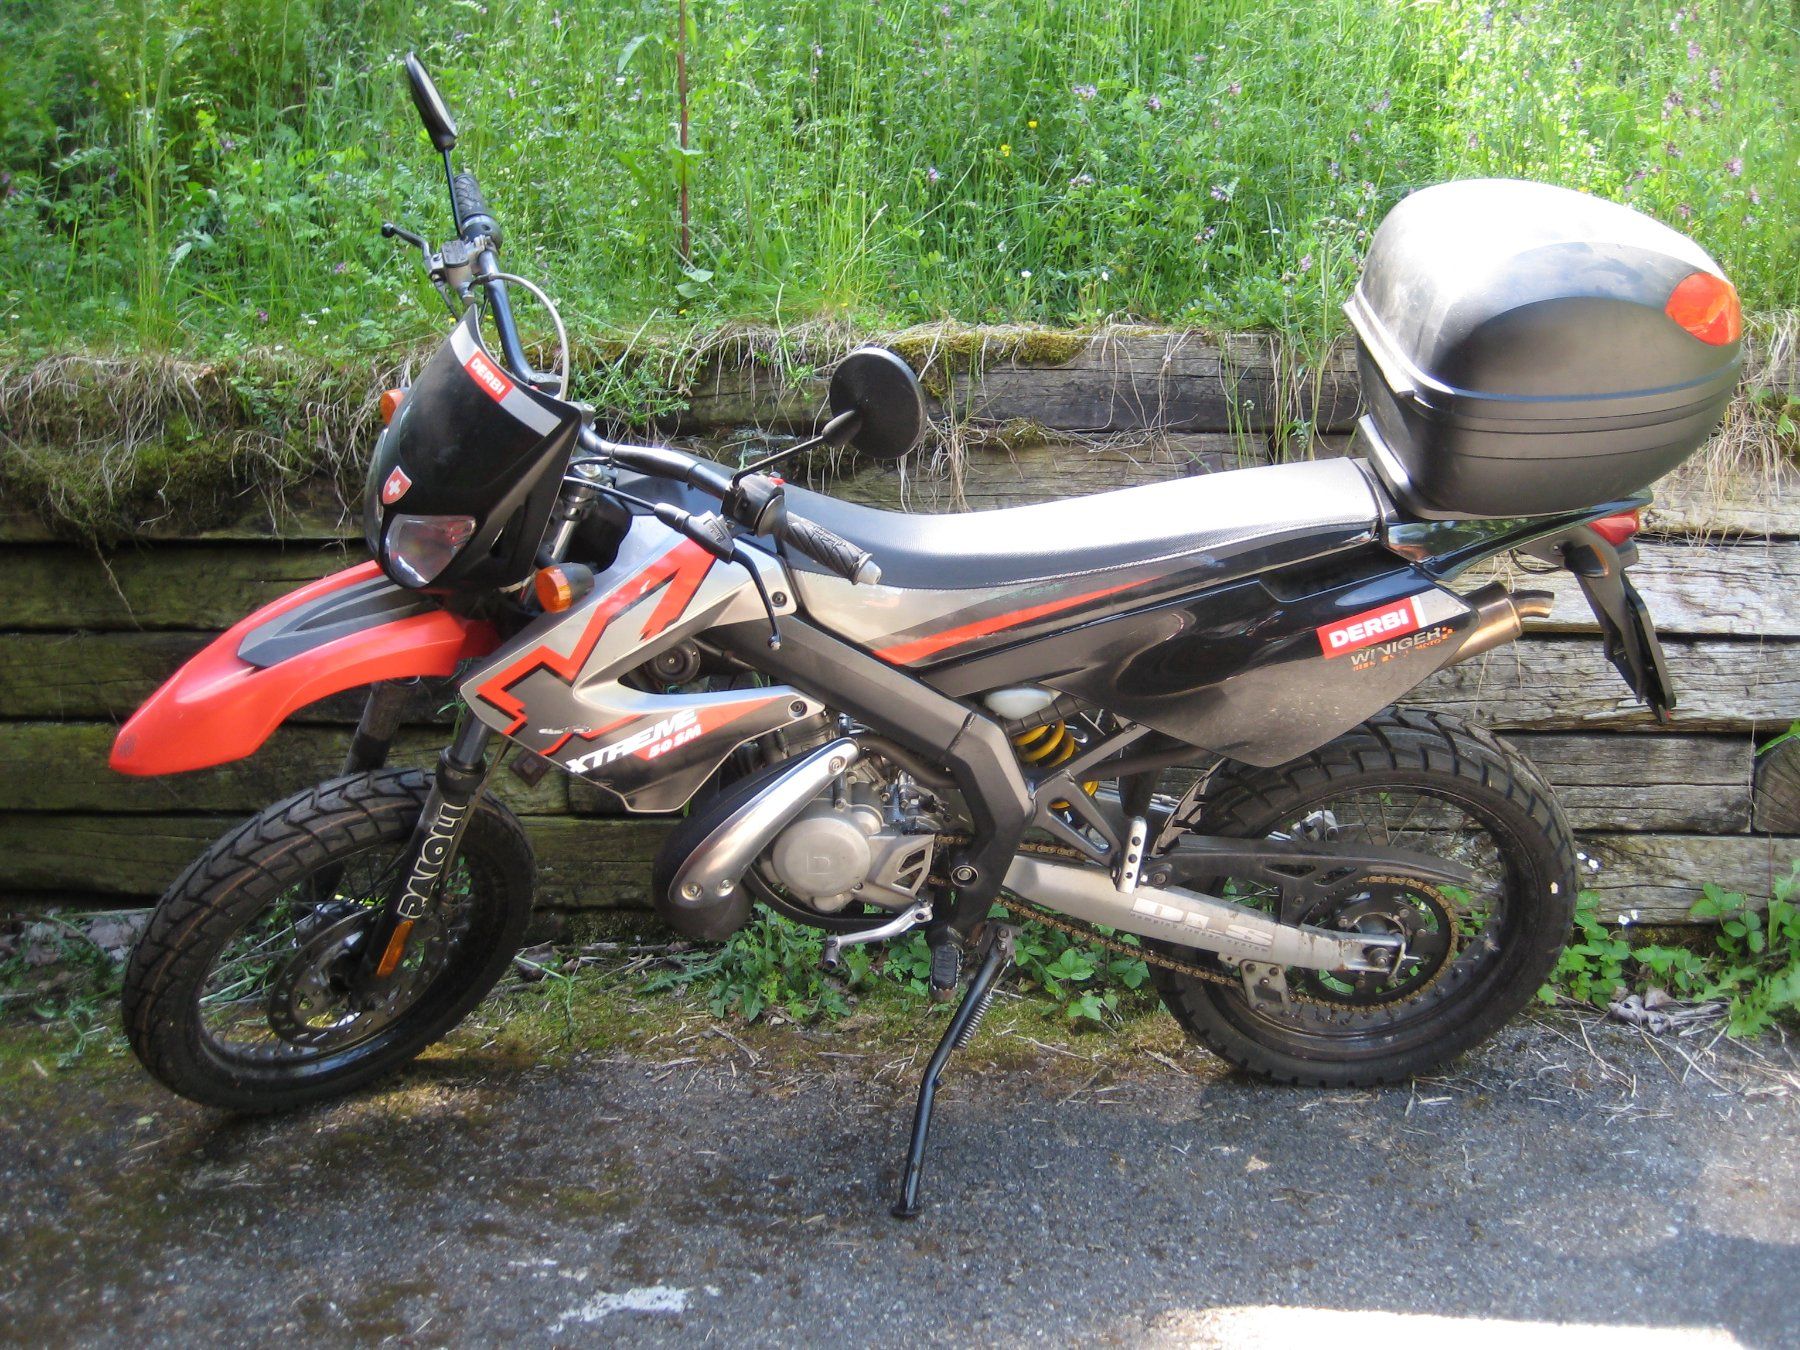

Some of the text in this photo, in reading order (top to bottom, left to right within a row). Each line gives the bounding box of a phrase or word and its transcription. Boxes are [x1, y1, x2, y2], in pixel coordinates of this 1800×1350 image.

[469, 357, 506, 396] DERBI
[1328, 608, 1410, 648] DERBI
[565, 708, 697, 773] XTREME
[648, 724, 702, 759] 50 SM
